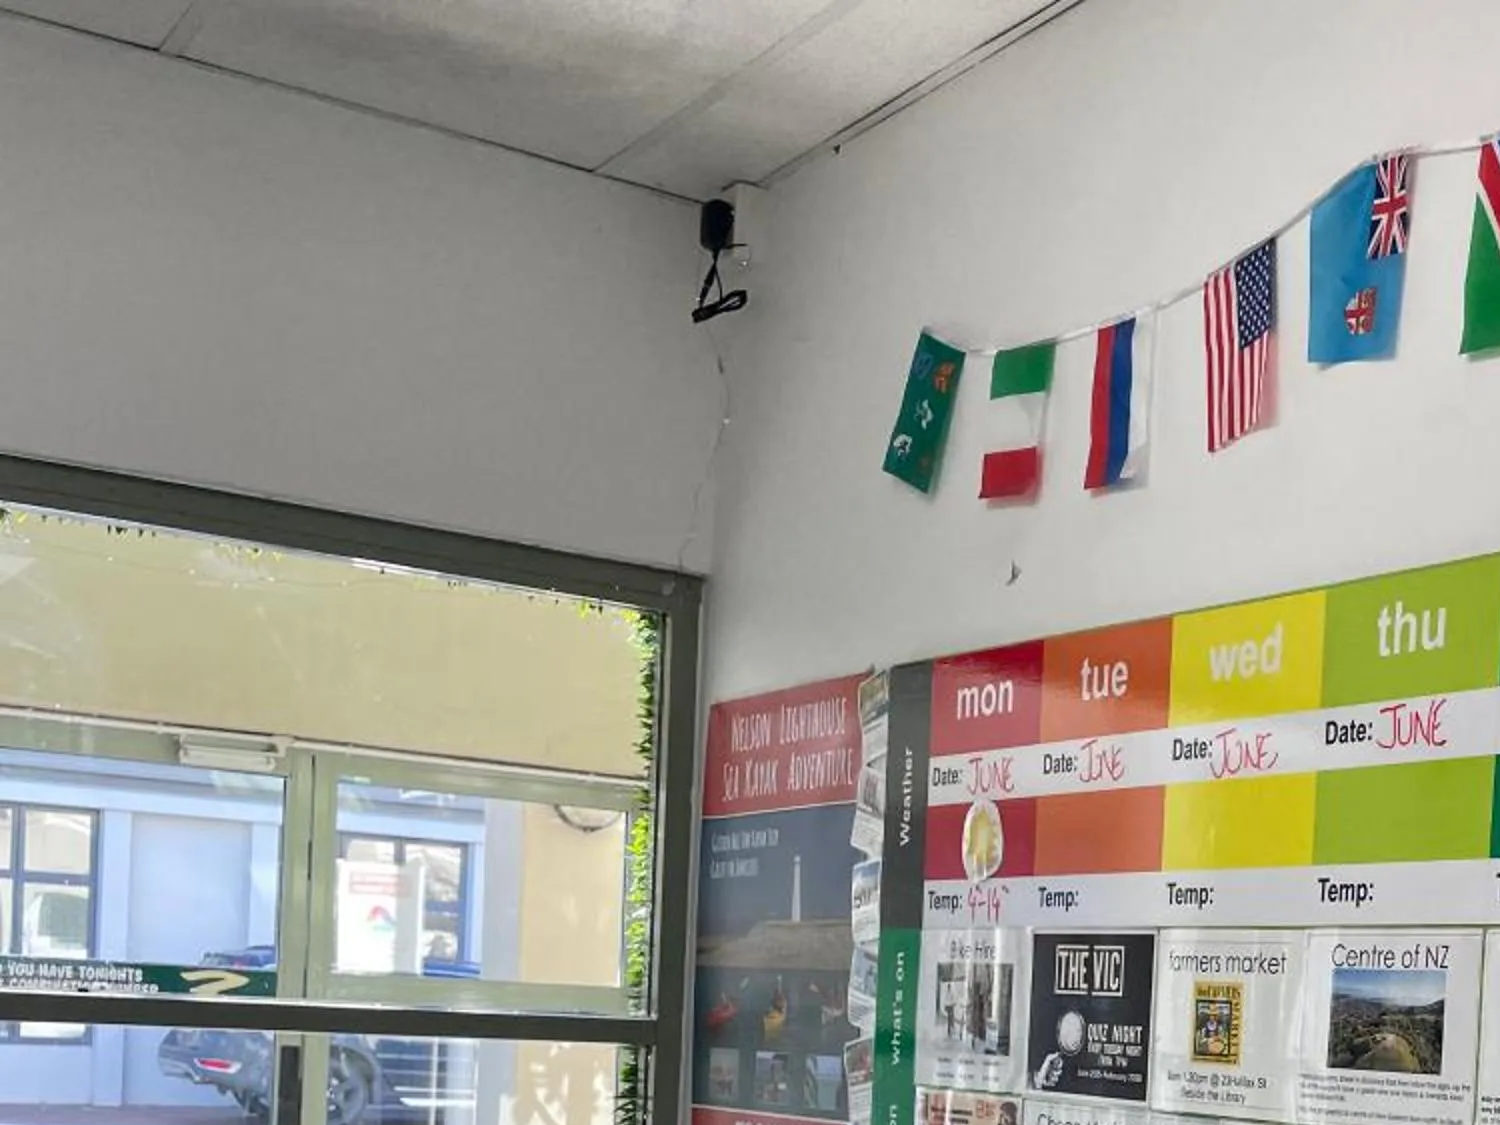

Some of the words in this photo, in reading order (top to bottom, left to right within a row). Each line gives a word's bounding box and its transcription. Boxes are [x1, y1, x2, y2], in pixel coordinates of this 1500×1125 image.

[1378, 602, 1446, 656] thu
[1210, 623, 1282, 682] wed
[1081, 657, 1128, 700] tue
[956, 679, 1014, 720] mon
[731, 712, 771, 752] NELSON
[780, 698, 848, 746] LIGHTHOUSE
[1325, 719, 1373, 745] Date:
[1376, 699, 1447, 749] JUNE
[1043, 753, 1078, 775] Date:
[1172, 737, 1213, 761] Date:
[1209, 728, 1279, 779] JUNE
[932, 766, 962, 787] Date:
[899, 747, 914, 846] Weather
[928, 890, 962, 914] Temp:
[1038, 886, 1078, 910] Temp:
[1167, 882, 1213, 908] Temp:
[1318, 878, 1374, 905] Temp:
[8, 964, 34, 977] YOU
[39, 965, 73, 980] HAVE
[77, 966, 143, 982] TONIGHTS
[896, 951, 904, 980] on
[1058, 951, 1089, 989] THE
[1092, 951, 1121, 990] VIC
[1169, 952, 1222, 973] farmers
[1225, 953, 1287, 975] market
[1332, 943, 1395, 968] Centre
[1401, 944, 1420, 968] of
[1425, 945, 1450, 969] NZ
[890, 989, 904, 1065] what's
